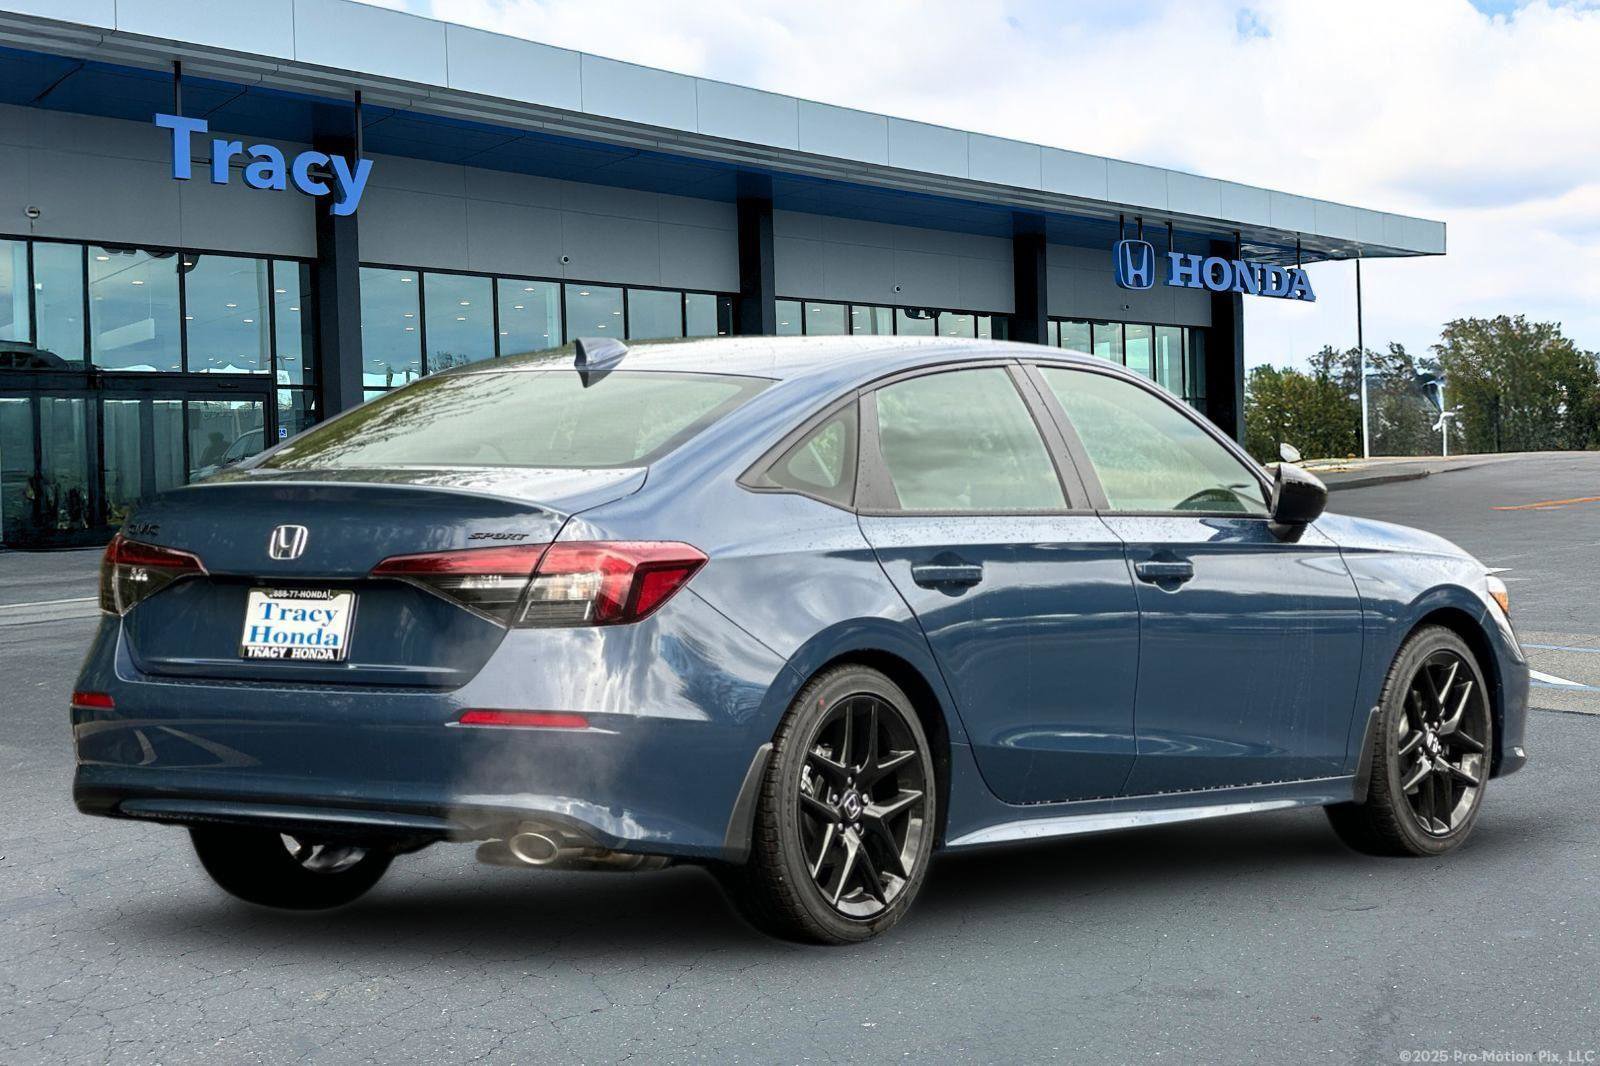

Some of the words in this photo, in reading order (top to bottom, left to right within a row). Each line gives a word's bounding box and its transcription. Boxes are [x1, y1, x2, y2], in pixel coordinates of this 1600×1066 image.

[154, 113, 374, 216] Tracy
[1166, 251, 1316, 302] HONDA
[468, 532, 530, 541] SPORT
[259, 602, 338, 627] Tracy
[249, 625, 339, 646] Honda
[247, 647, 287, 658] TRACY
[292, 648, 334, 660] HONDA
